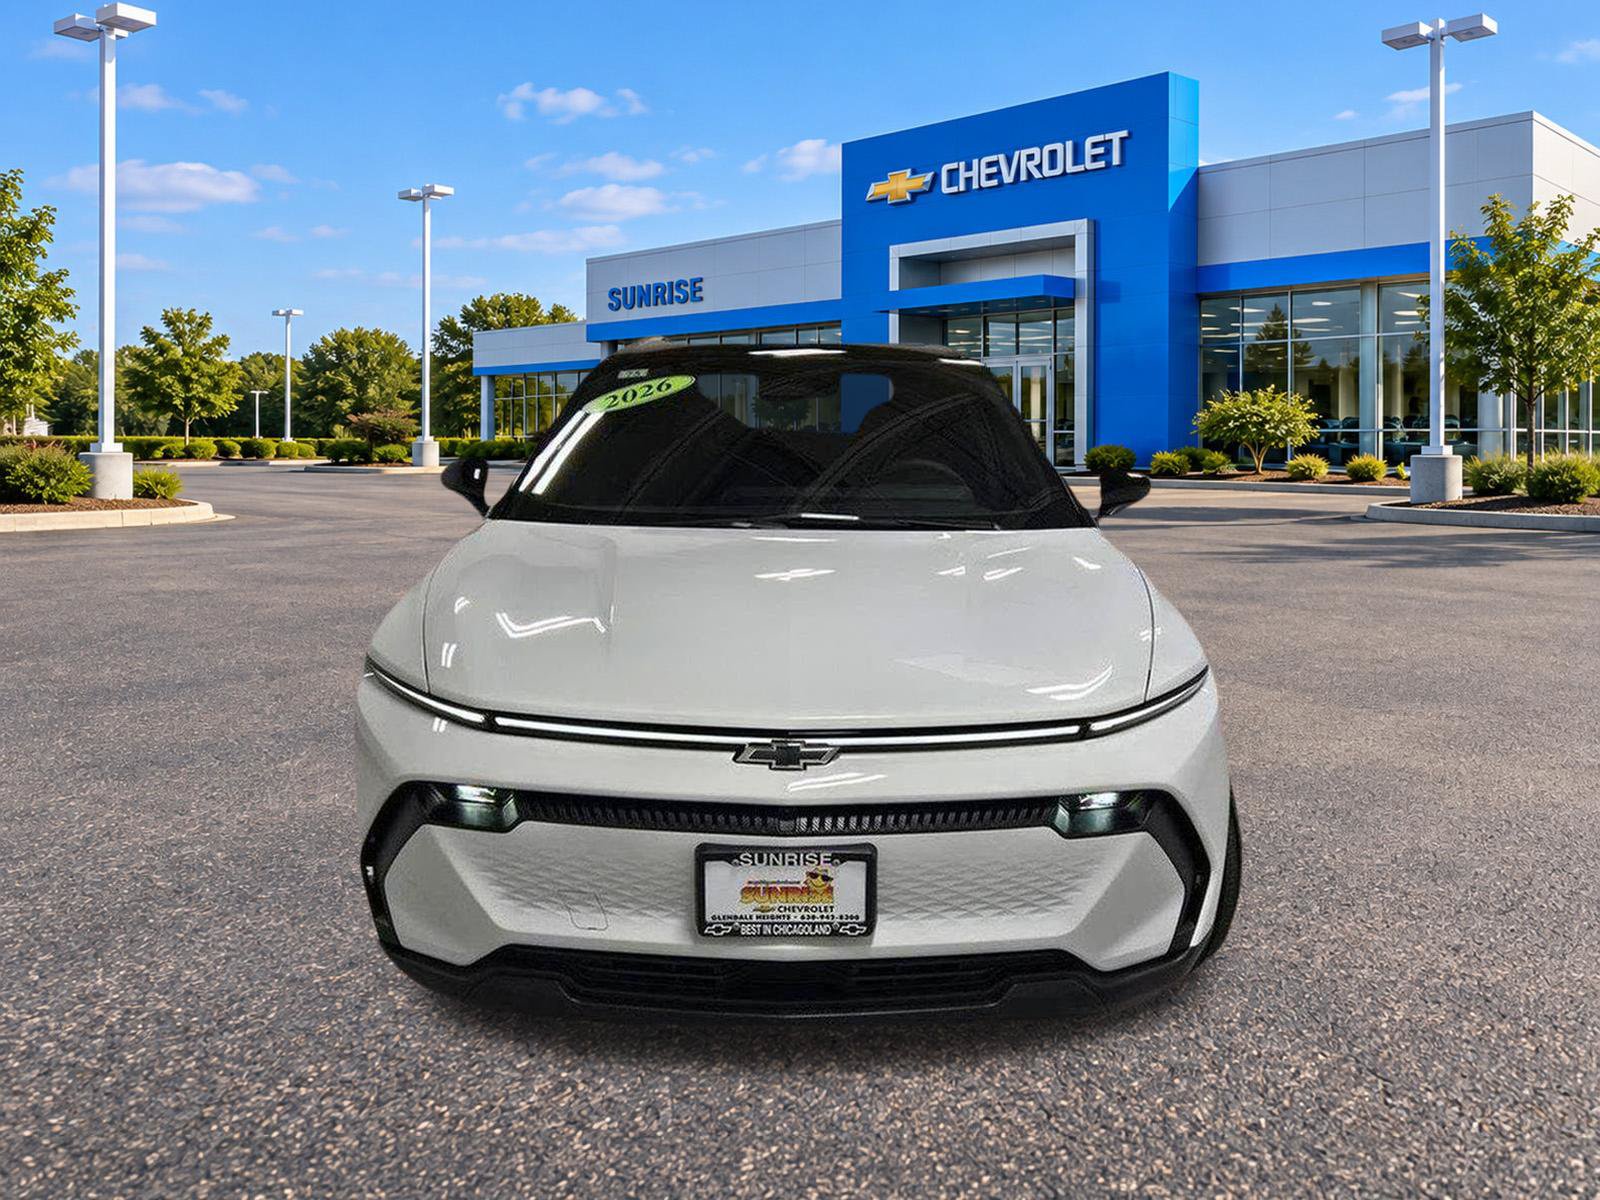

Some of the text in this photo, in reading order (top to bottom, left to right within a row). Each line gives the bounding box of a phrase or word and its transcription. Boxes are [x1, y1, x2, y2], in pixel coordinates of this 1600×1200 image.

[941, 130, 1129, 194] CHEVROLET
[608, 277, 704, 312] SUNRISE
[605, 379, 672, 408] 2026
[740, 852, 833, 867] SUNRISE
[777, 905, 835, 913] CHEVROLET
[740, 923, 832, 936] BEST IN CHICAGOLAND
